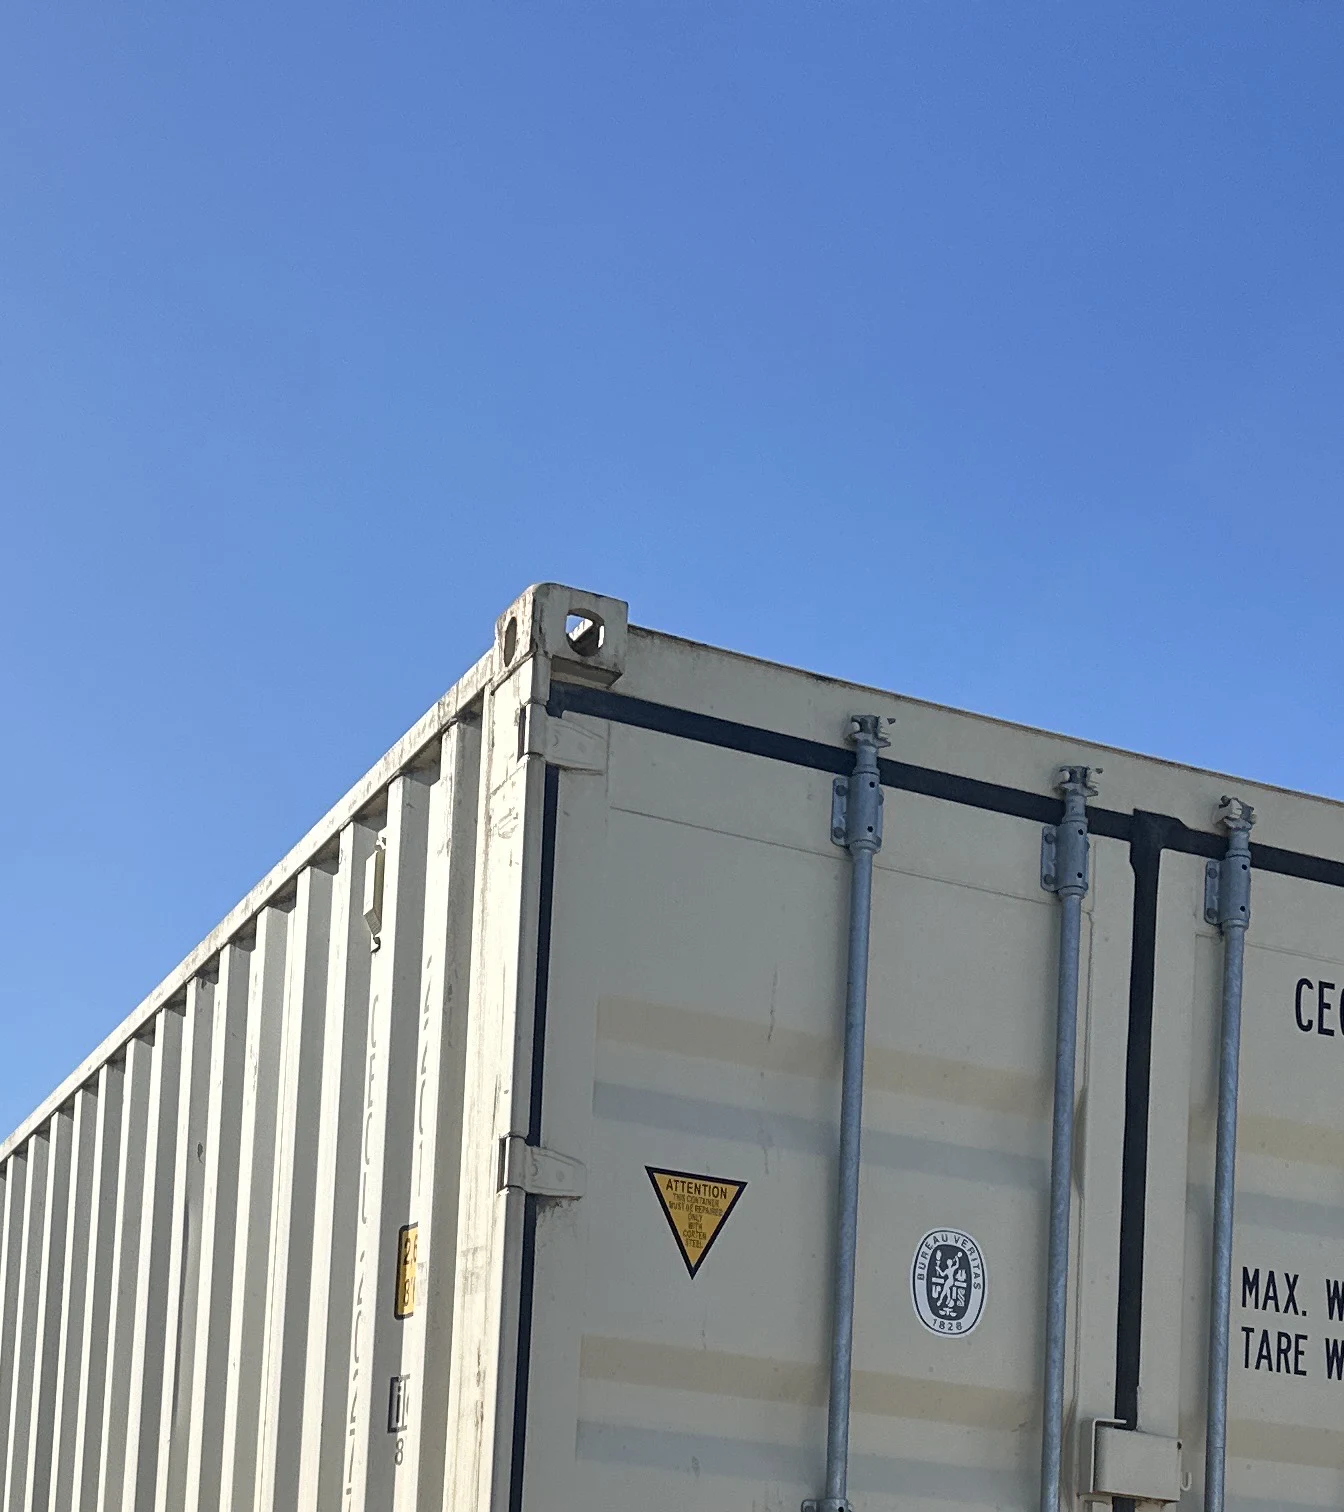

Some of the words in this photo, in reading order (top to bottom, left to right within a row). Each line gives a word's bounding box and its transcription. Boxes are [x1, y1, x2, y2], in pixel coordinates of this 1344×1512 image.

[665, 1178, 728, 1200] ATTENTION
[917, 1234, 949, 1281] BUREAU
[954, 1235, 981, 1290] VERITAS
[1242, 1266, 1308, 1317] MAX.
[932, 1319, 963, 1331] 1828
[1241, 1326, 1308, 1376] TARE
